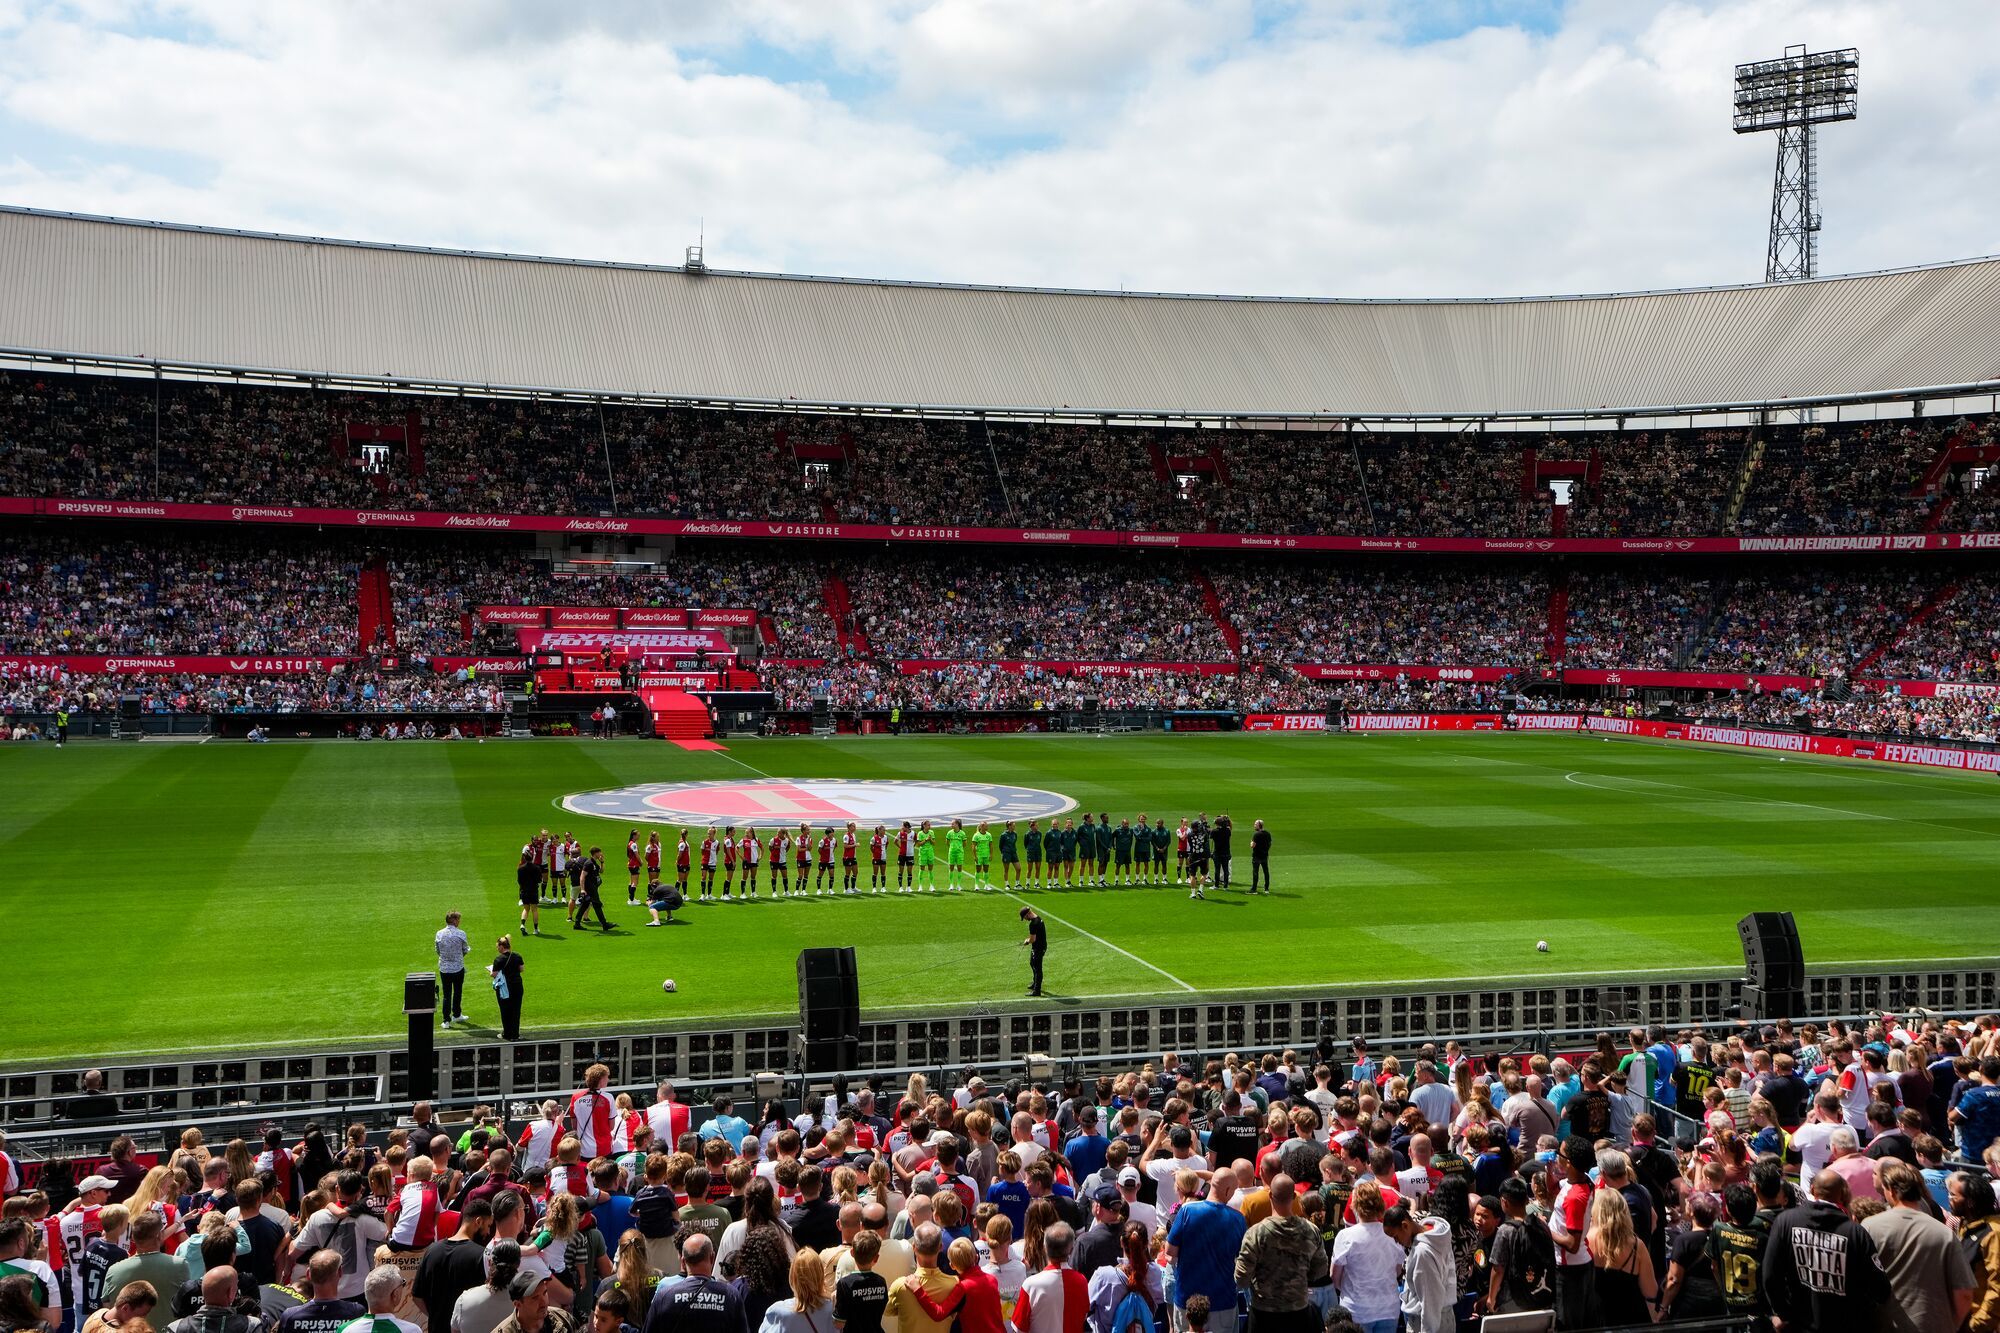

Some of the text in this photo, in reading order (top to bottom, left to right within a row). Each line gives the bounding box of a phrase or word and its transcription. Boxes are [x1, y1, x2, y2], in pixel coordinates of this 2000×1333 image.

[117, 506, 166, 516] vakanties
[787, 526, 840, 535] CASTORE
[909, 529, 960, 538] CASTORE
[1241, 537, 1272, 545] Heineken
[1361, 540, 1393, 548] Heineken
[1485, 541, 1524, 550] Dusseldorp
[1622, 541, 1663, 550] Dusseldorp
[1739, 538, 1805, 551] WINNAAR
[1805, 536, 1882, 550] EUROPACUP
[1892, 535, 1926, 549] 1970
[1960, 534, 1974, 547] 14
[542, 633, 708, 641] FEYENOORD
[1321, 668, 1353, 676] Heineken
[644, 678, 682, 686] FESTIVAL
[1283, 715, 1429, 729] FEYEND VROUWEN 1
[1517, 715, 1578, 729] YENOORD
[1587, 717, 1629, 733] ROUWEN
[1688, 726, 1748, 746] FEYENOORD
[1748, 731, 1804, 750] VROUWEN
[1884, 744, 1965, 768] FEYENOORD
[1688, 1073, 1710, 1096] 10
[1794, 1228, 1845, 1252] STRAIGHT
[1796, 1246, 1843, 1274] OUTTA
[1722, 1250, 1757, 1296] 19
[88, 1269, 100, 1300] 5
[690, 1302, 725, 1311] vakanties
[294, 1319, 349, 1330] PRIJSVR
